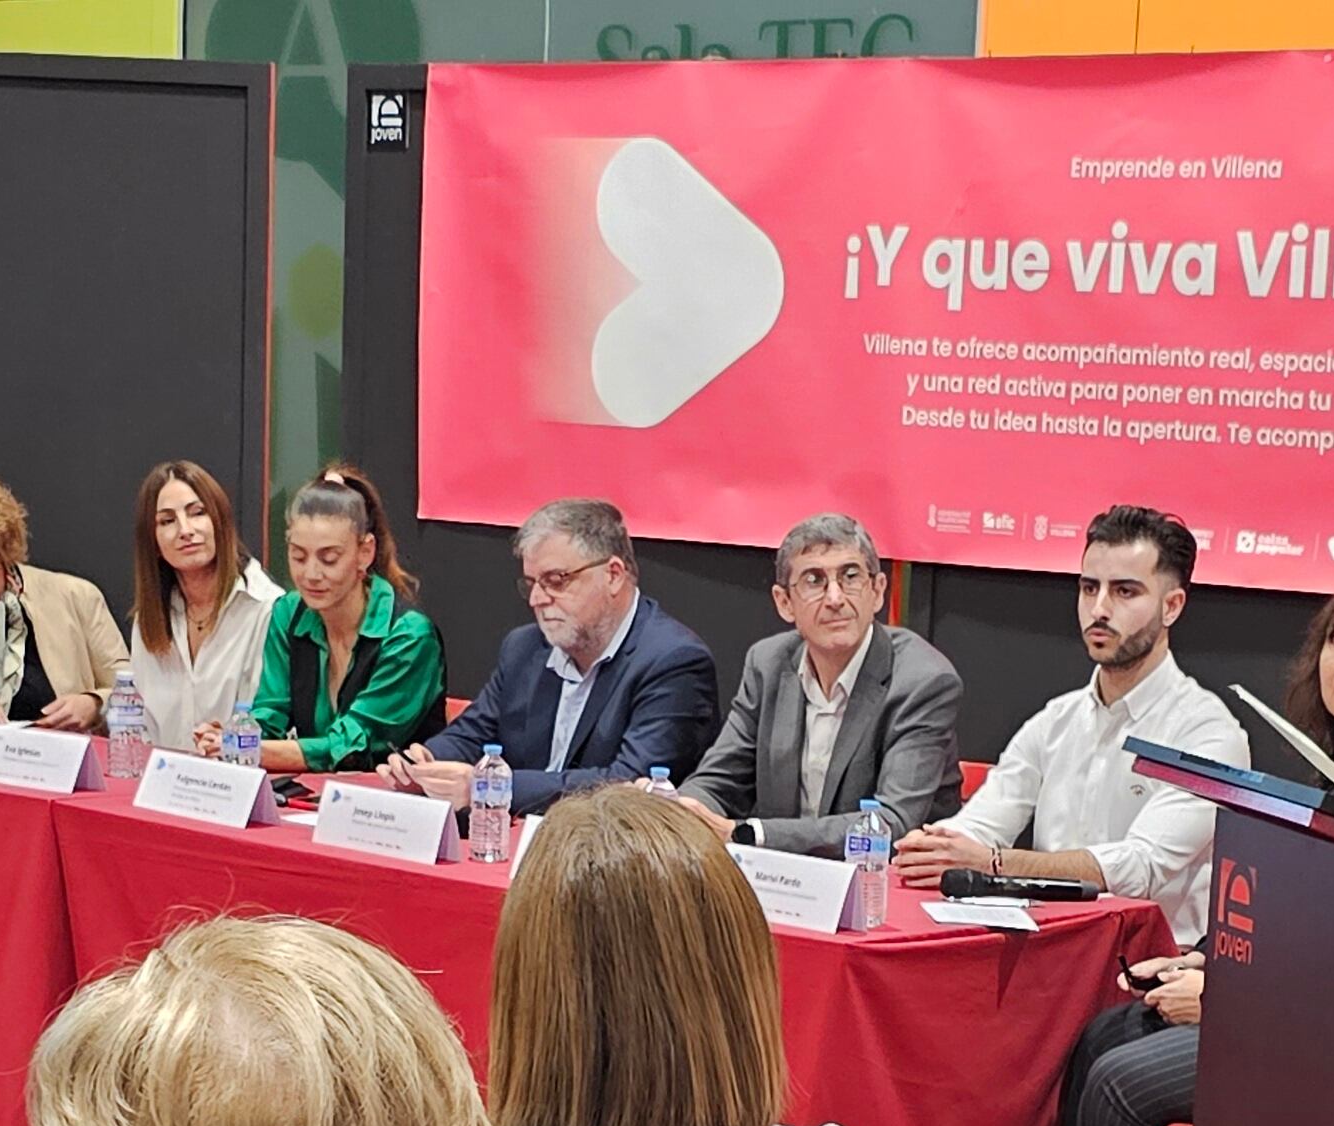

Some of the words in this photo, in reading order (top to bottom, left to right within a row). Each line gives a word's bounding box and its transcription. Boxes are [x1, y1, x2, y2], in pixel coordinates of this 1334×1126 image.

[371, 127, 403, 144] joven
[1070, 155, 1174, 183] Emprende
[1179, 160, 1206, 179] en
[1212, 156, 1283, 180] Villena
[845, 223, 910, 299] ¡Y
[922, 237, 1051, 311] que
[1067, 220, 1217, 297] viva
[863, 333, 927, 357] Villena
[932, 338, 953, 358] te
[956, 336, 1019, 361] ofrece
[1022, 341, 1205, 369] acompañamiento
[1209, 347, 1254, 373] real,
[906, 373, 919, 397] y
[924, 374, 964, 393] una
[968, 374, 1001, 395] red
[1005, 375, 1066, 398] activa
[1071, 382, 1118, 405] para
[1123, 384, 1183, 408] poner
[1187, 386, 1213, 405] en
[1219, 387, 1303, 410] marcha
[1309, 389, 1331, 411] tu
[902, 405, 965, 428] Desde
[970, 411, 989, 430] tu
[994, 409, 1037, 432] idea
[1042, 412, 1099, 436] hasta
[1104, 415, 1121, 438] la
[1126, 418, 1221, 445] apertura.
[1228, 422, 1252, 444] Te
